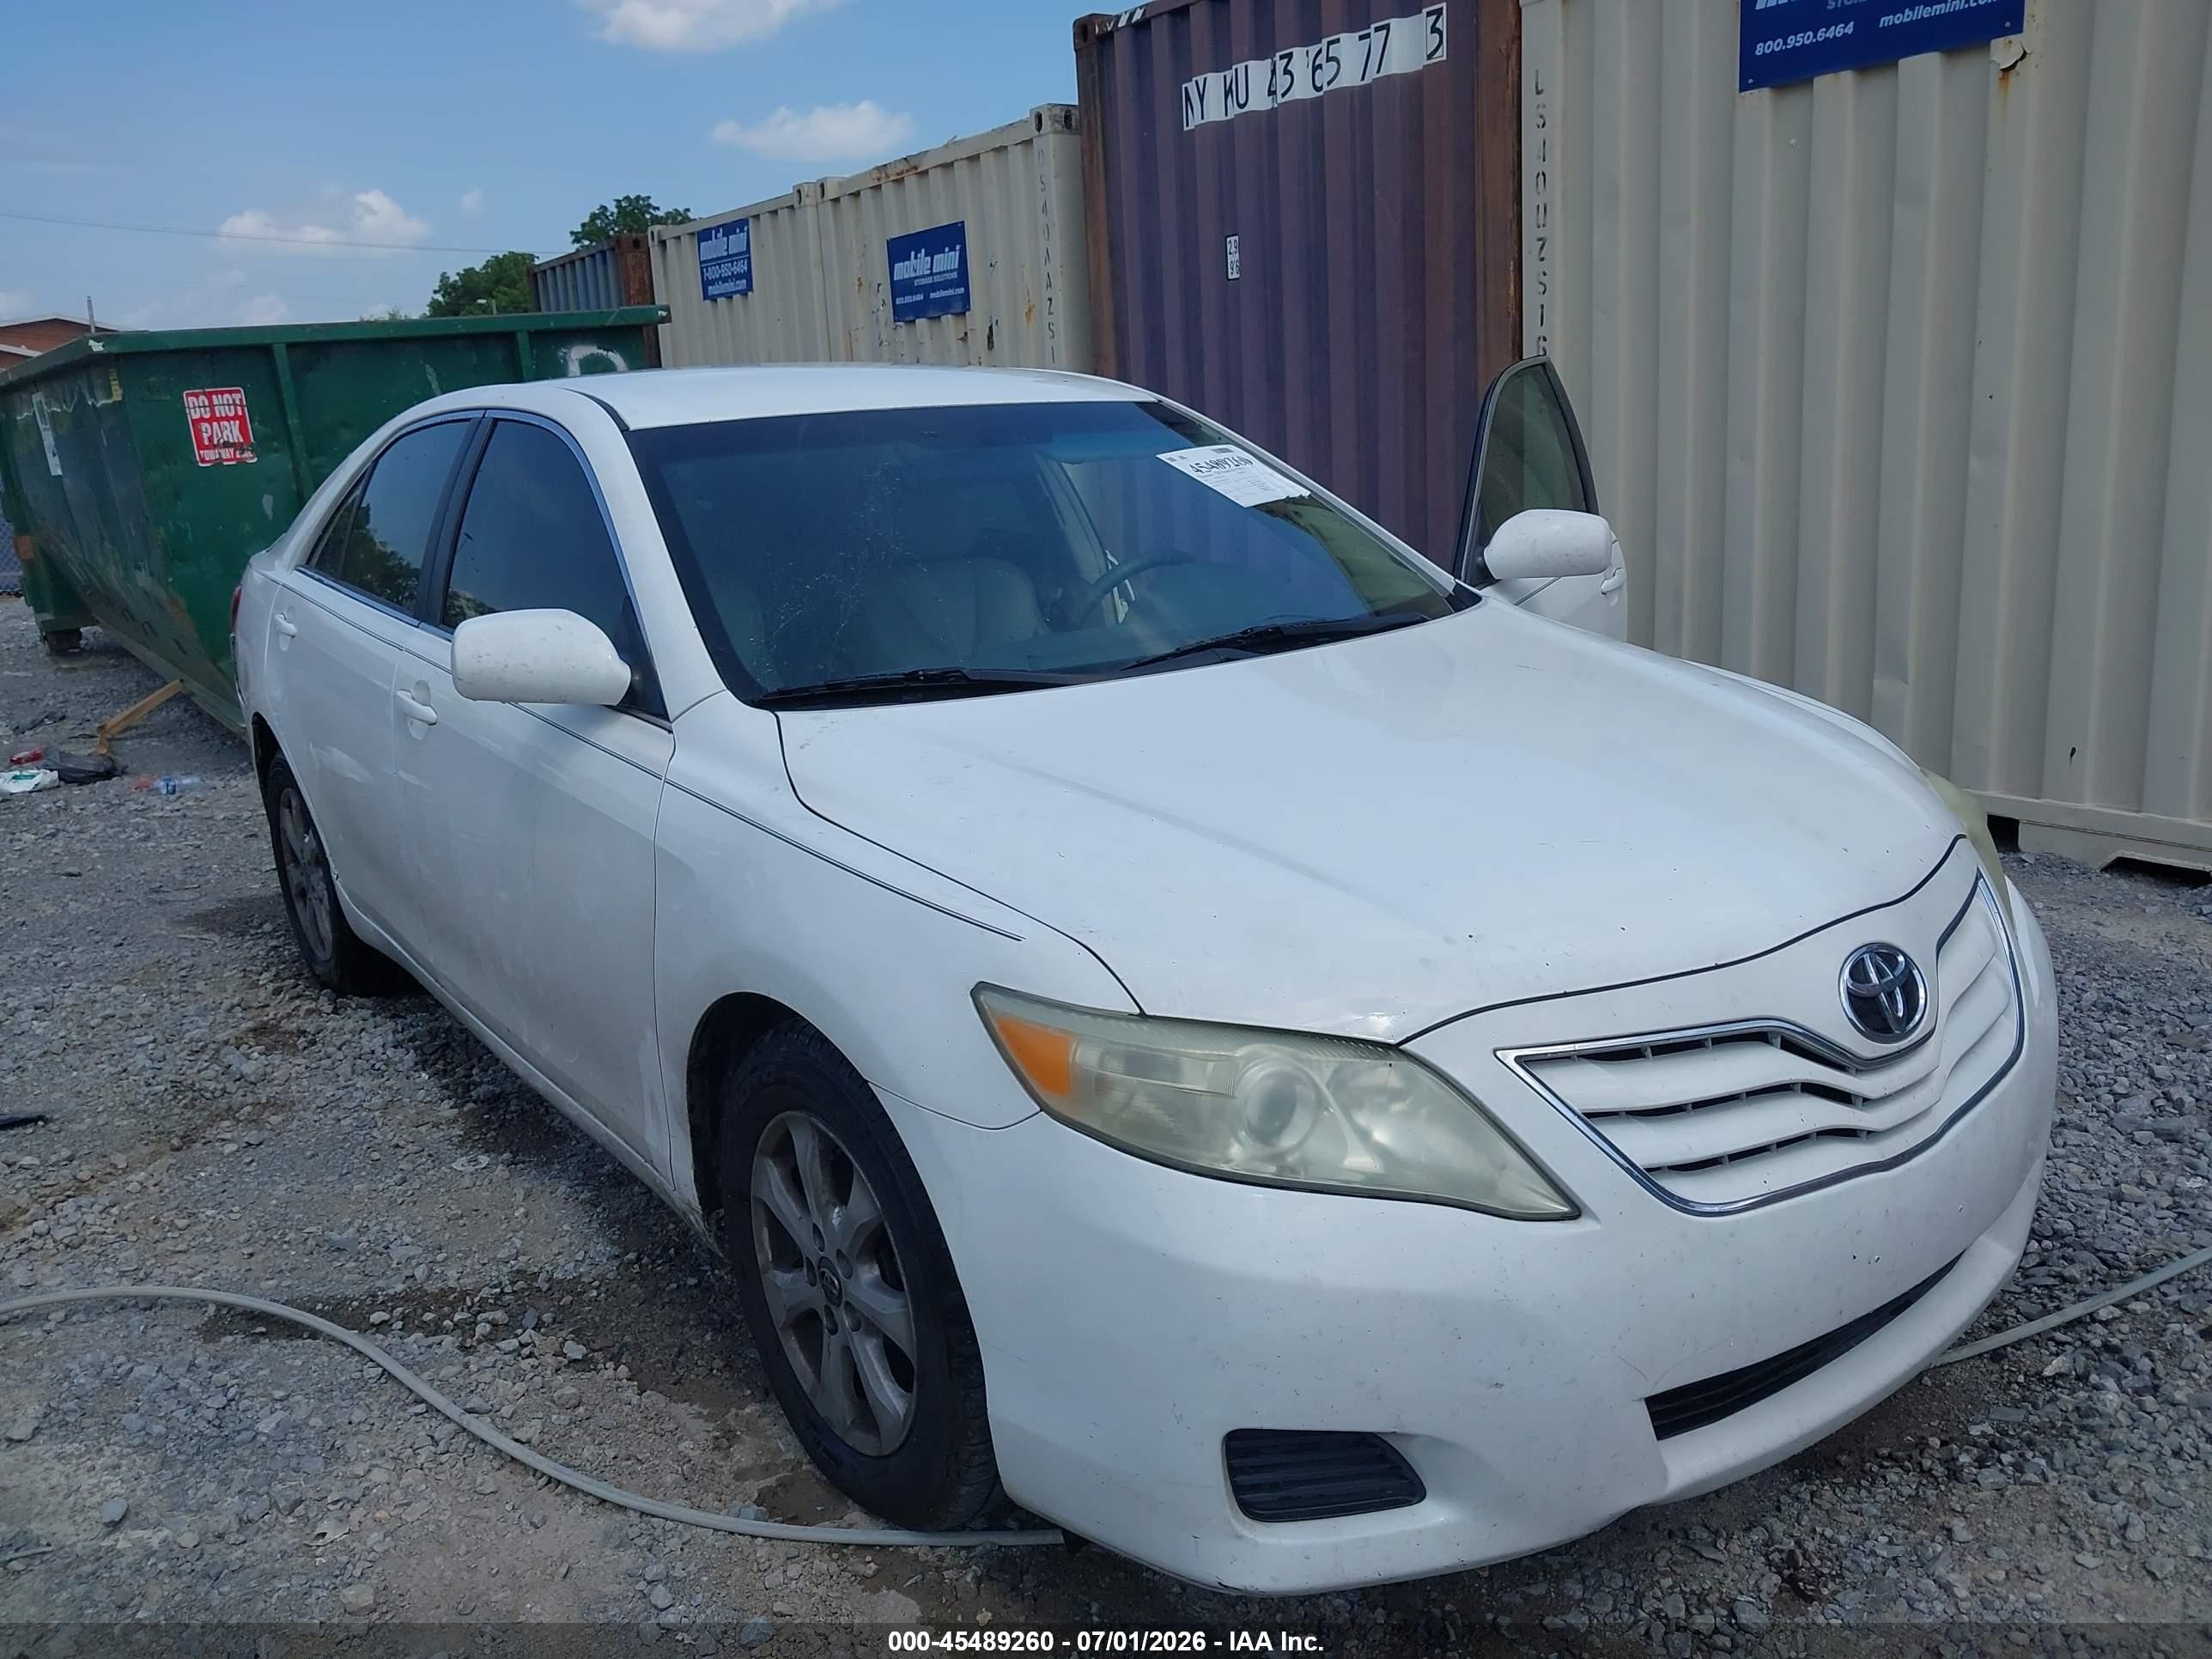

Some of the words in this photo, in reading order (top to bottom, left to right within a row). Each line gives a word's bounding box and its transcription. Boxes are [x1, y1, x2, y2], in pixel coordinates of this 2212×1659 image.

[1425, 7, 1443, 61] 3
[1755, 21, 1855, 56] 800.950.6464
[701, 228, 728, 261] mobile
[729, 226, 748, 255] mini
[894, 248, 932, 282] mobile
[933, 245, 961, 273] mini
[188, 395, 211, 419] DO
[212, 392, 243, 417] NOT
[200, 420, 244, 446] PARK
